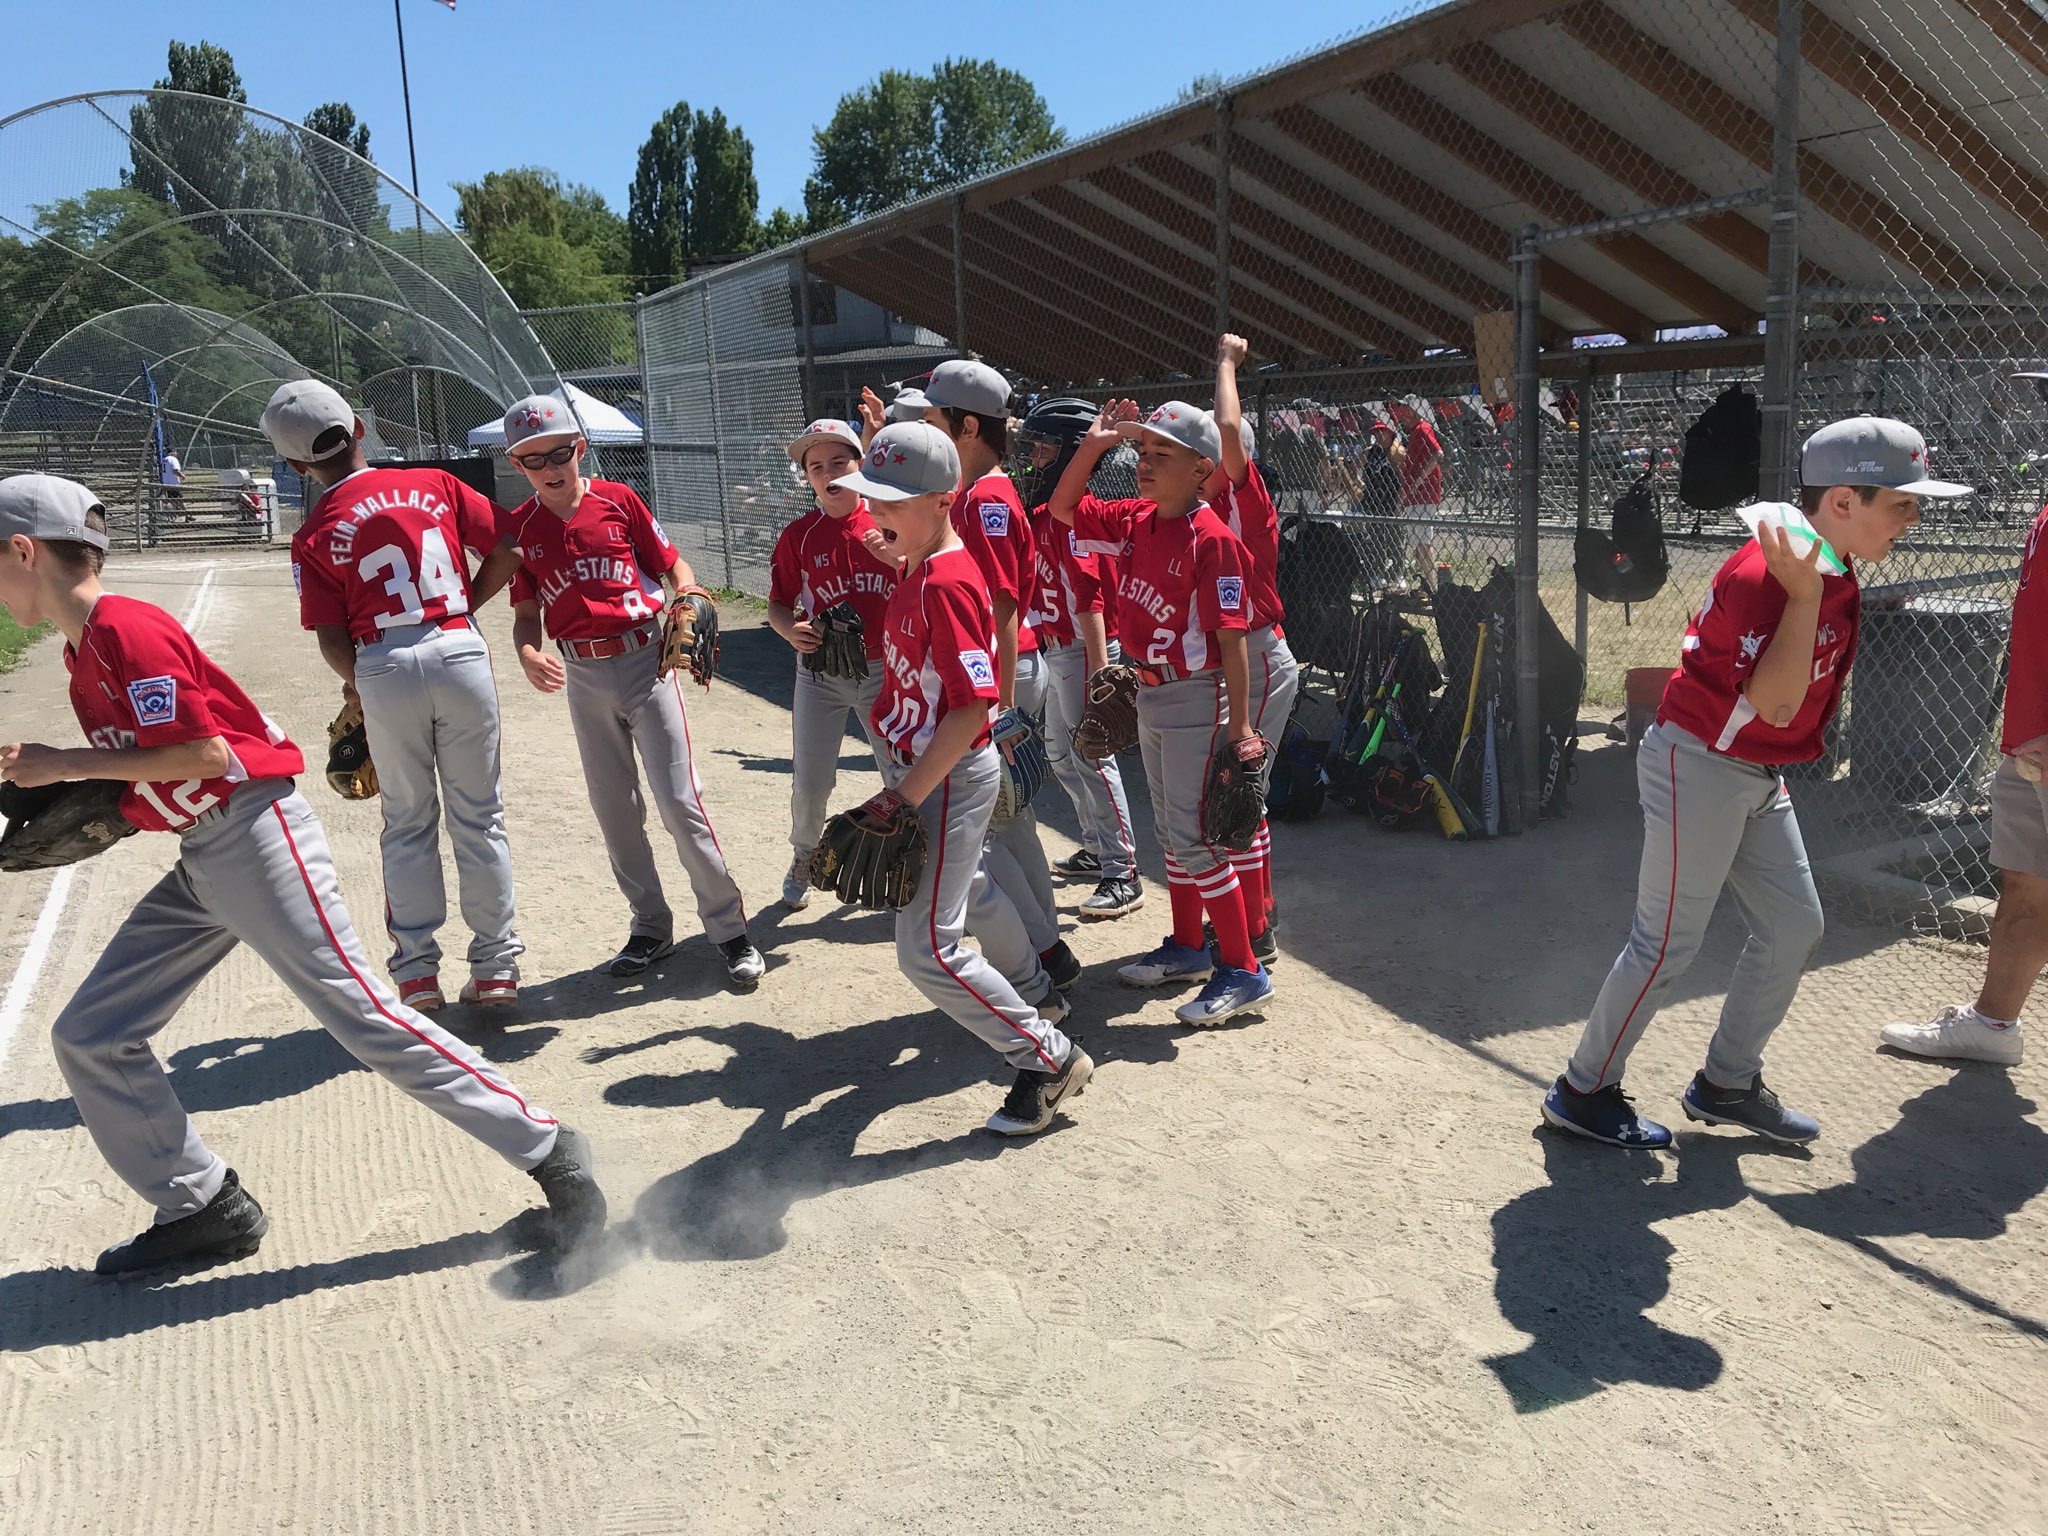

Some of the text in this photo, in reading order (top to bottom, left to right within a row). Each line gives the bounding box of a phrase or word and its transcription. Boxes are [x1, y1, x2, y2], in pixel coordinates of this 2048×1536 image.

[1845, 465, 1885, 473] ALL STARS
[330, 488, 451, 567] FEIN-WALLACE
[607, 525, 623, 542] LL
[527, 543, 545, 561] WS
[813, 553, 830, 569] WS
[1167, 557, 1182, 577] LL
[357, 526, 469, 630] 34
[539, 556, 635, 608] ALL STARS
[815, 574, 850, 604] ALL
[1041, 588, 1060, 623] 5
[1127, 577, 1177, 624] STARS
[900, 614, 915, 638] LL
[1817, 622, 1837, 647] WS
[1147, 627, 1177, 665] 2
[878, 689, 921, 745] 10
[133, 778, 222, 828] 12
[1483, 773, 1493, 822] LOUISVILLE
